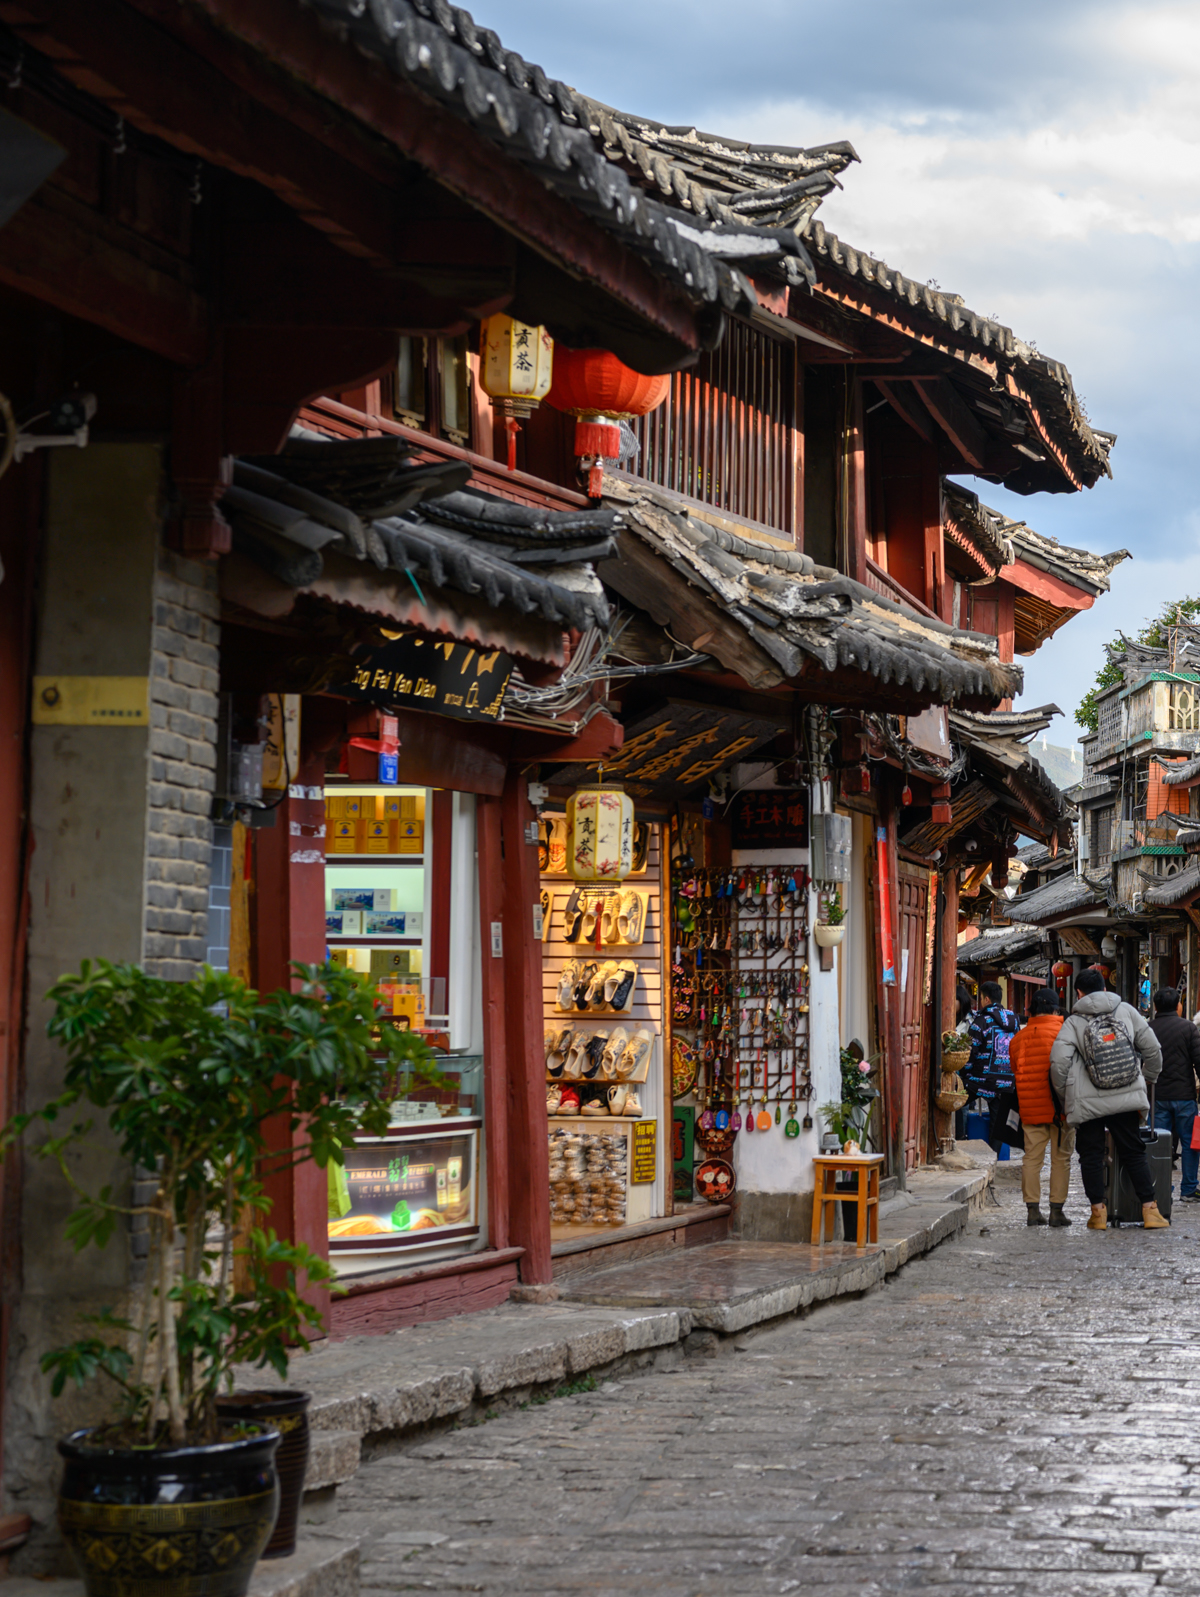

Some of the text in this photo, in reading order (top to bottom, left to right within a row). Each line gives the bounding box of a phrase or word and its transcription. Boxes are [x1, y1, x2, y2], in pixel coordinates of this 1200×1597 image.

[351, 665, 437, 699] ing Fei Yan Dian
[740, 803, 804, 829] 手工木雕
[351, 1170, 387, 1180] EMERALD
